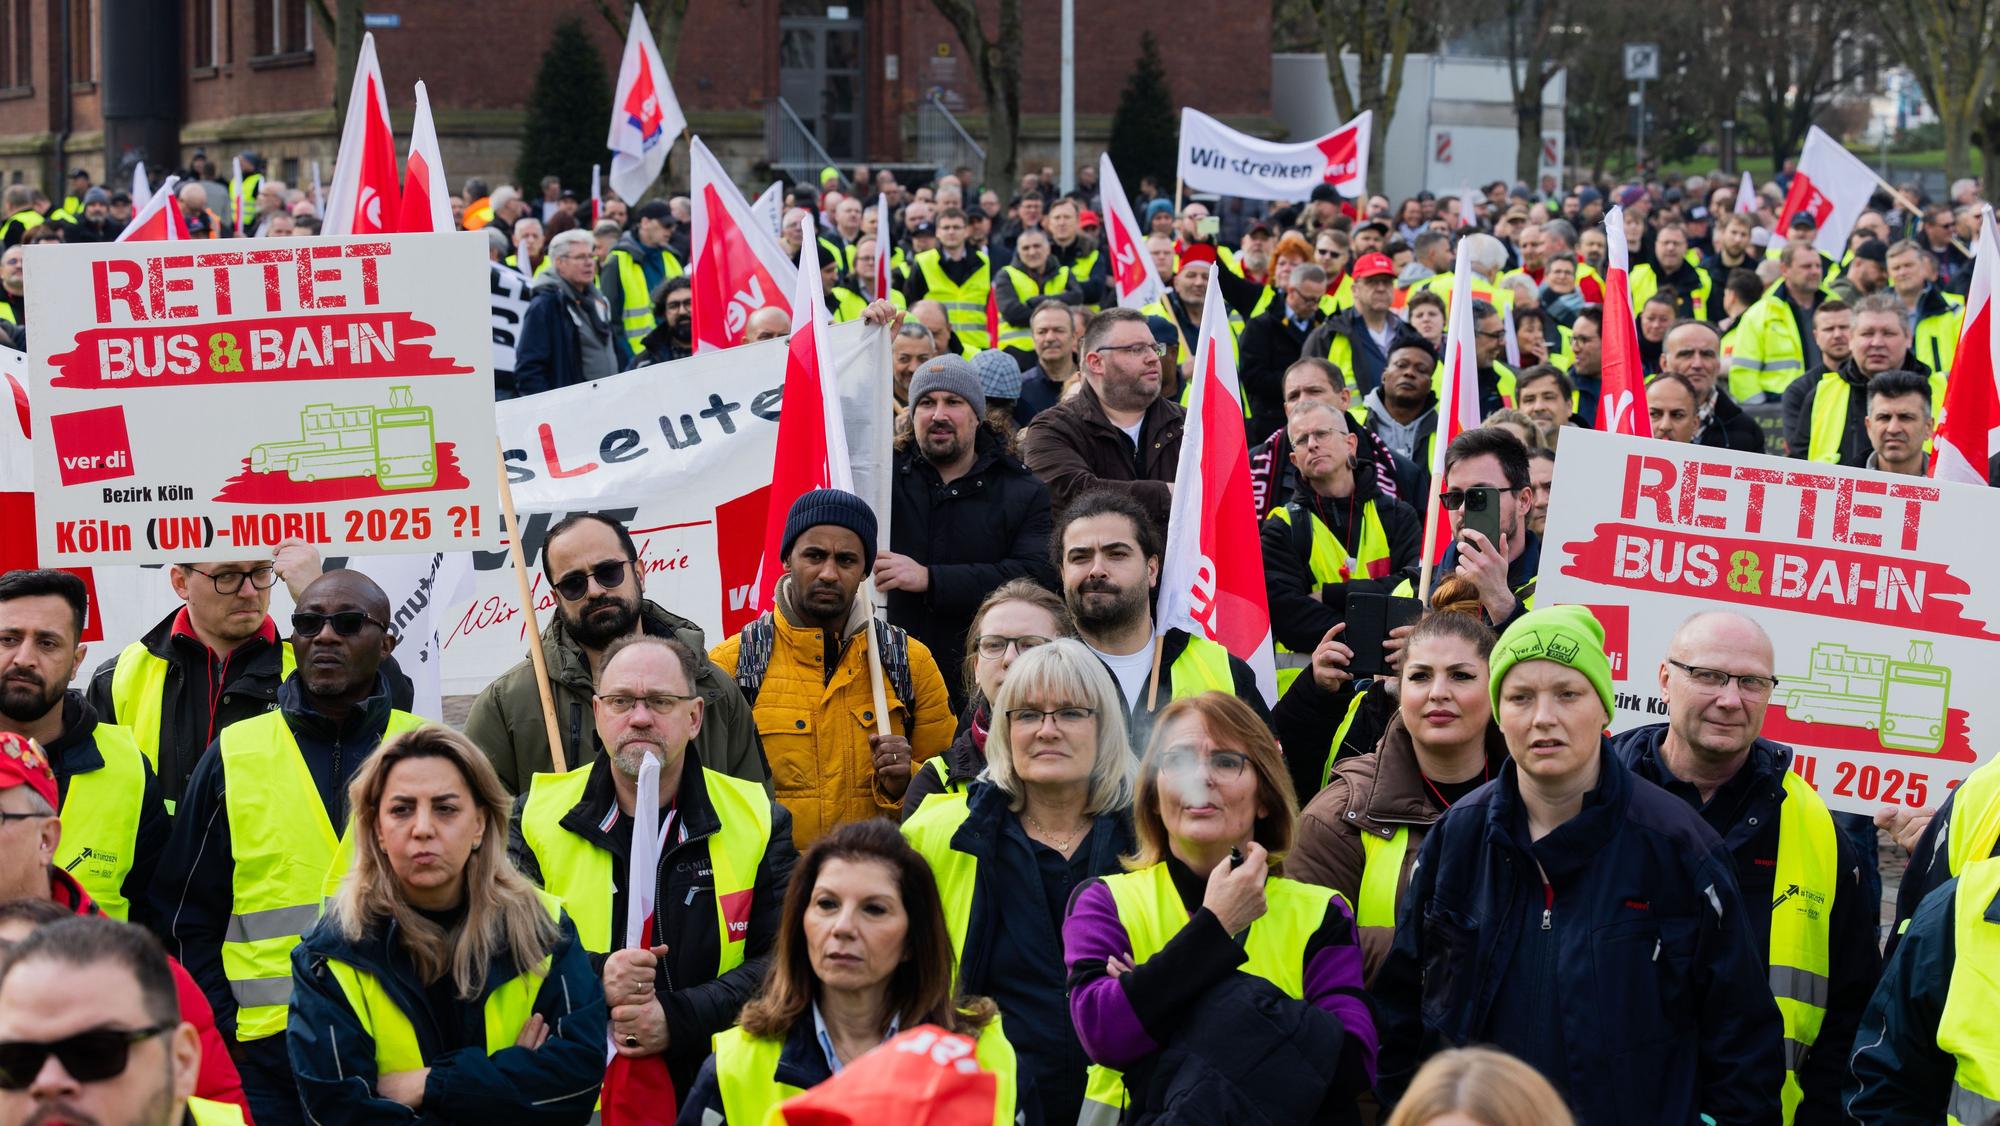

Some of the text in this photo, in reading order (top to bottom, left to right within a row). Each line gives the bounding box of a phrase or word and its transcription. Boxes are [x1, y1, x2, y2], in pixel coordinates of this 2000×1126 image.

[91, 242, 391, 323] RETTET
[64, 450, 127, 470] ver.di
[102, 485, 194, 503] Bezirk Köln
[1620, 453, 1940, 551] RETTET
[56, 519, 131, 554] Köln
[345, 507, 431, 543] 2025
[447, 505, 481, 539] ?!
[443, 596, 520, 649] Wir
[1833, 761, 1929, 808] 2025
